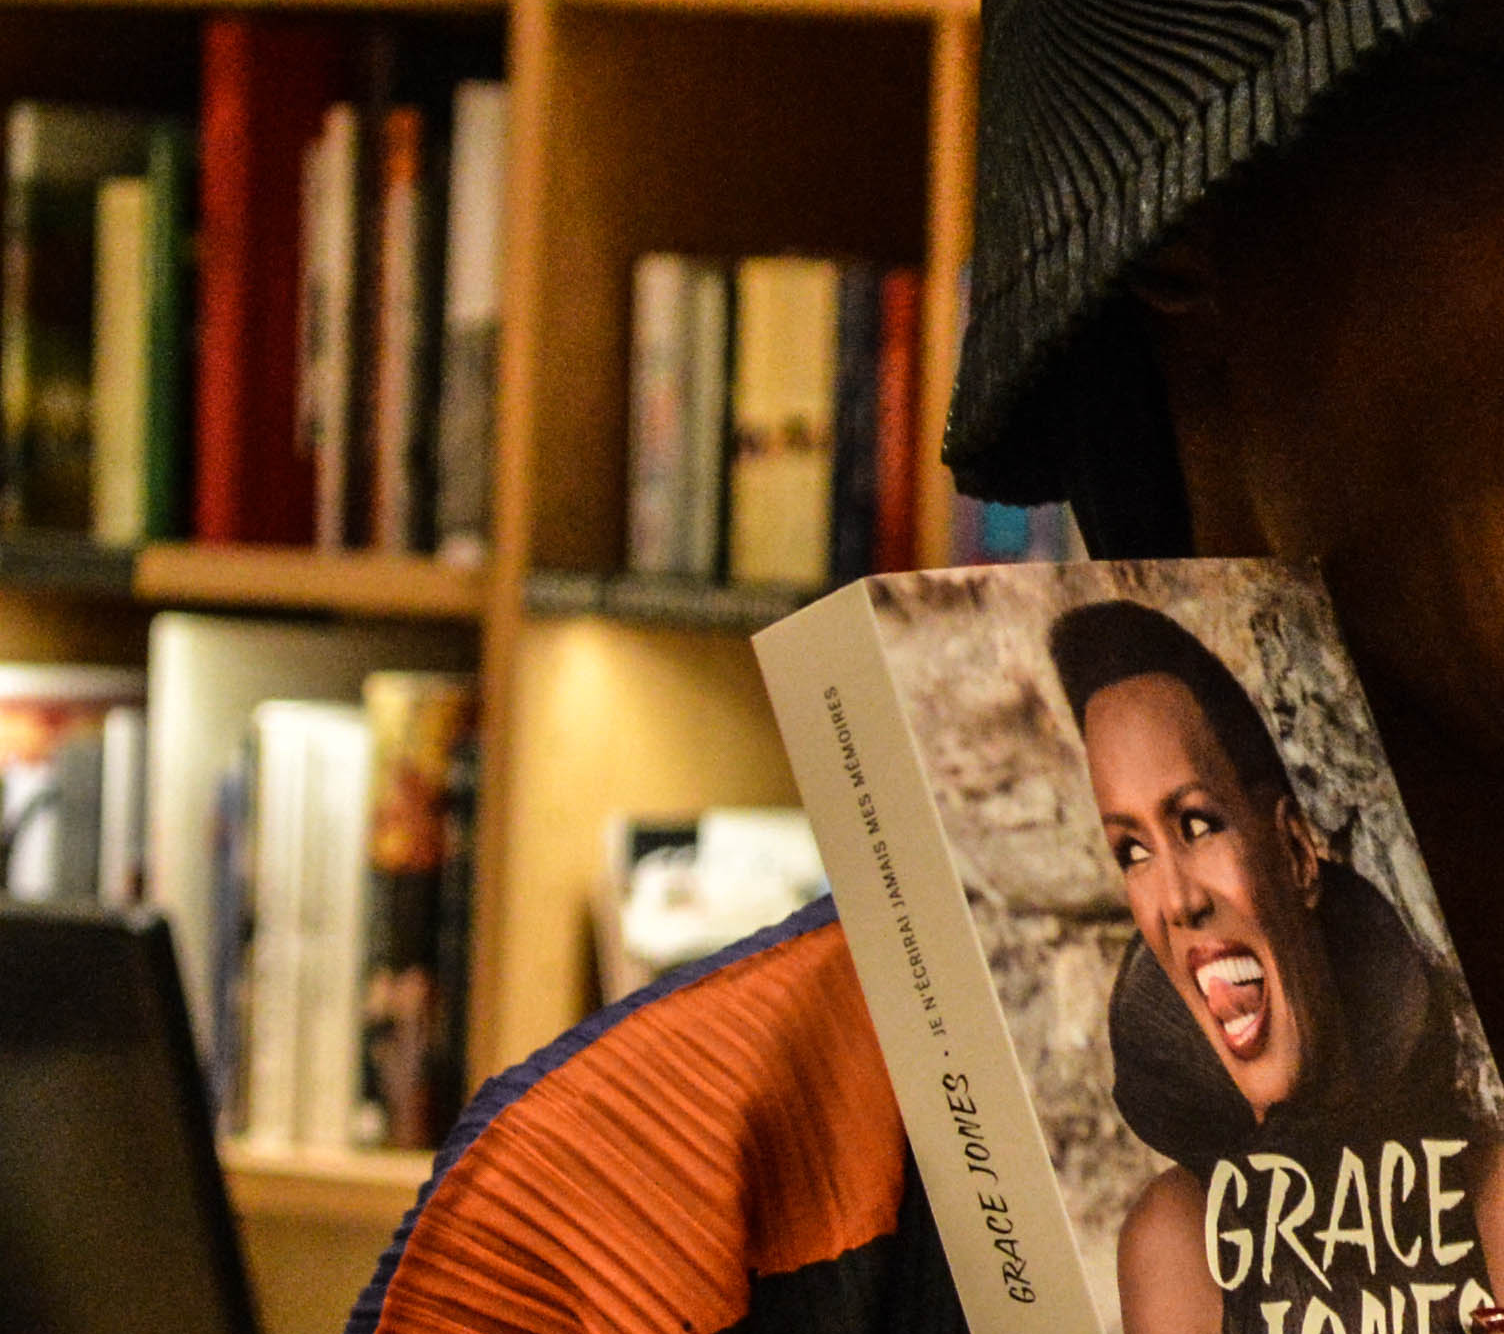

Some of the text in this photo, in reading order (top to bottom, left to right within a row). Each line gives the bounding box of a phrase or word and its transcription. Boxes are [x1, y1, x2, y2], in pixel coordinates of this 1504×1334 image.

[824, 686, 865, 788] MÉMOIRES
[857, 793, 881, 835] MES
[873, 840, 905, 908] JAMAIS
[928, 1018, 946, 1036] JE
[942, 1073, 998, 1185] JONES
[978, 1192, 1036, 1305] GRACE
[1205, 1139, 1474, 1291] GRACE
